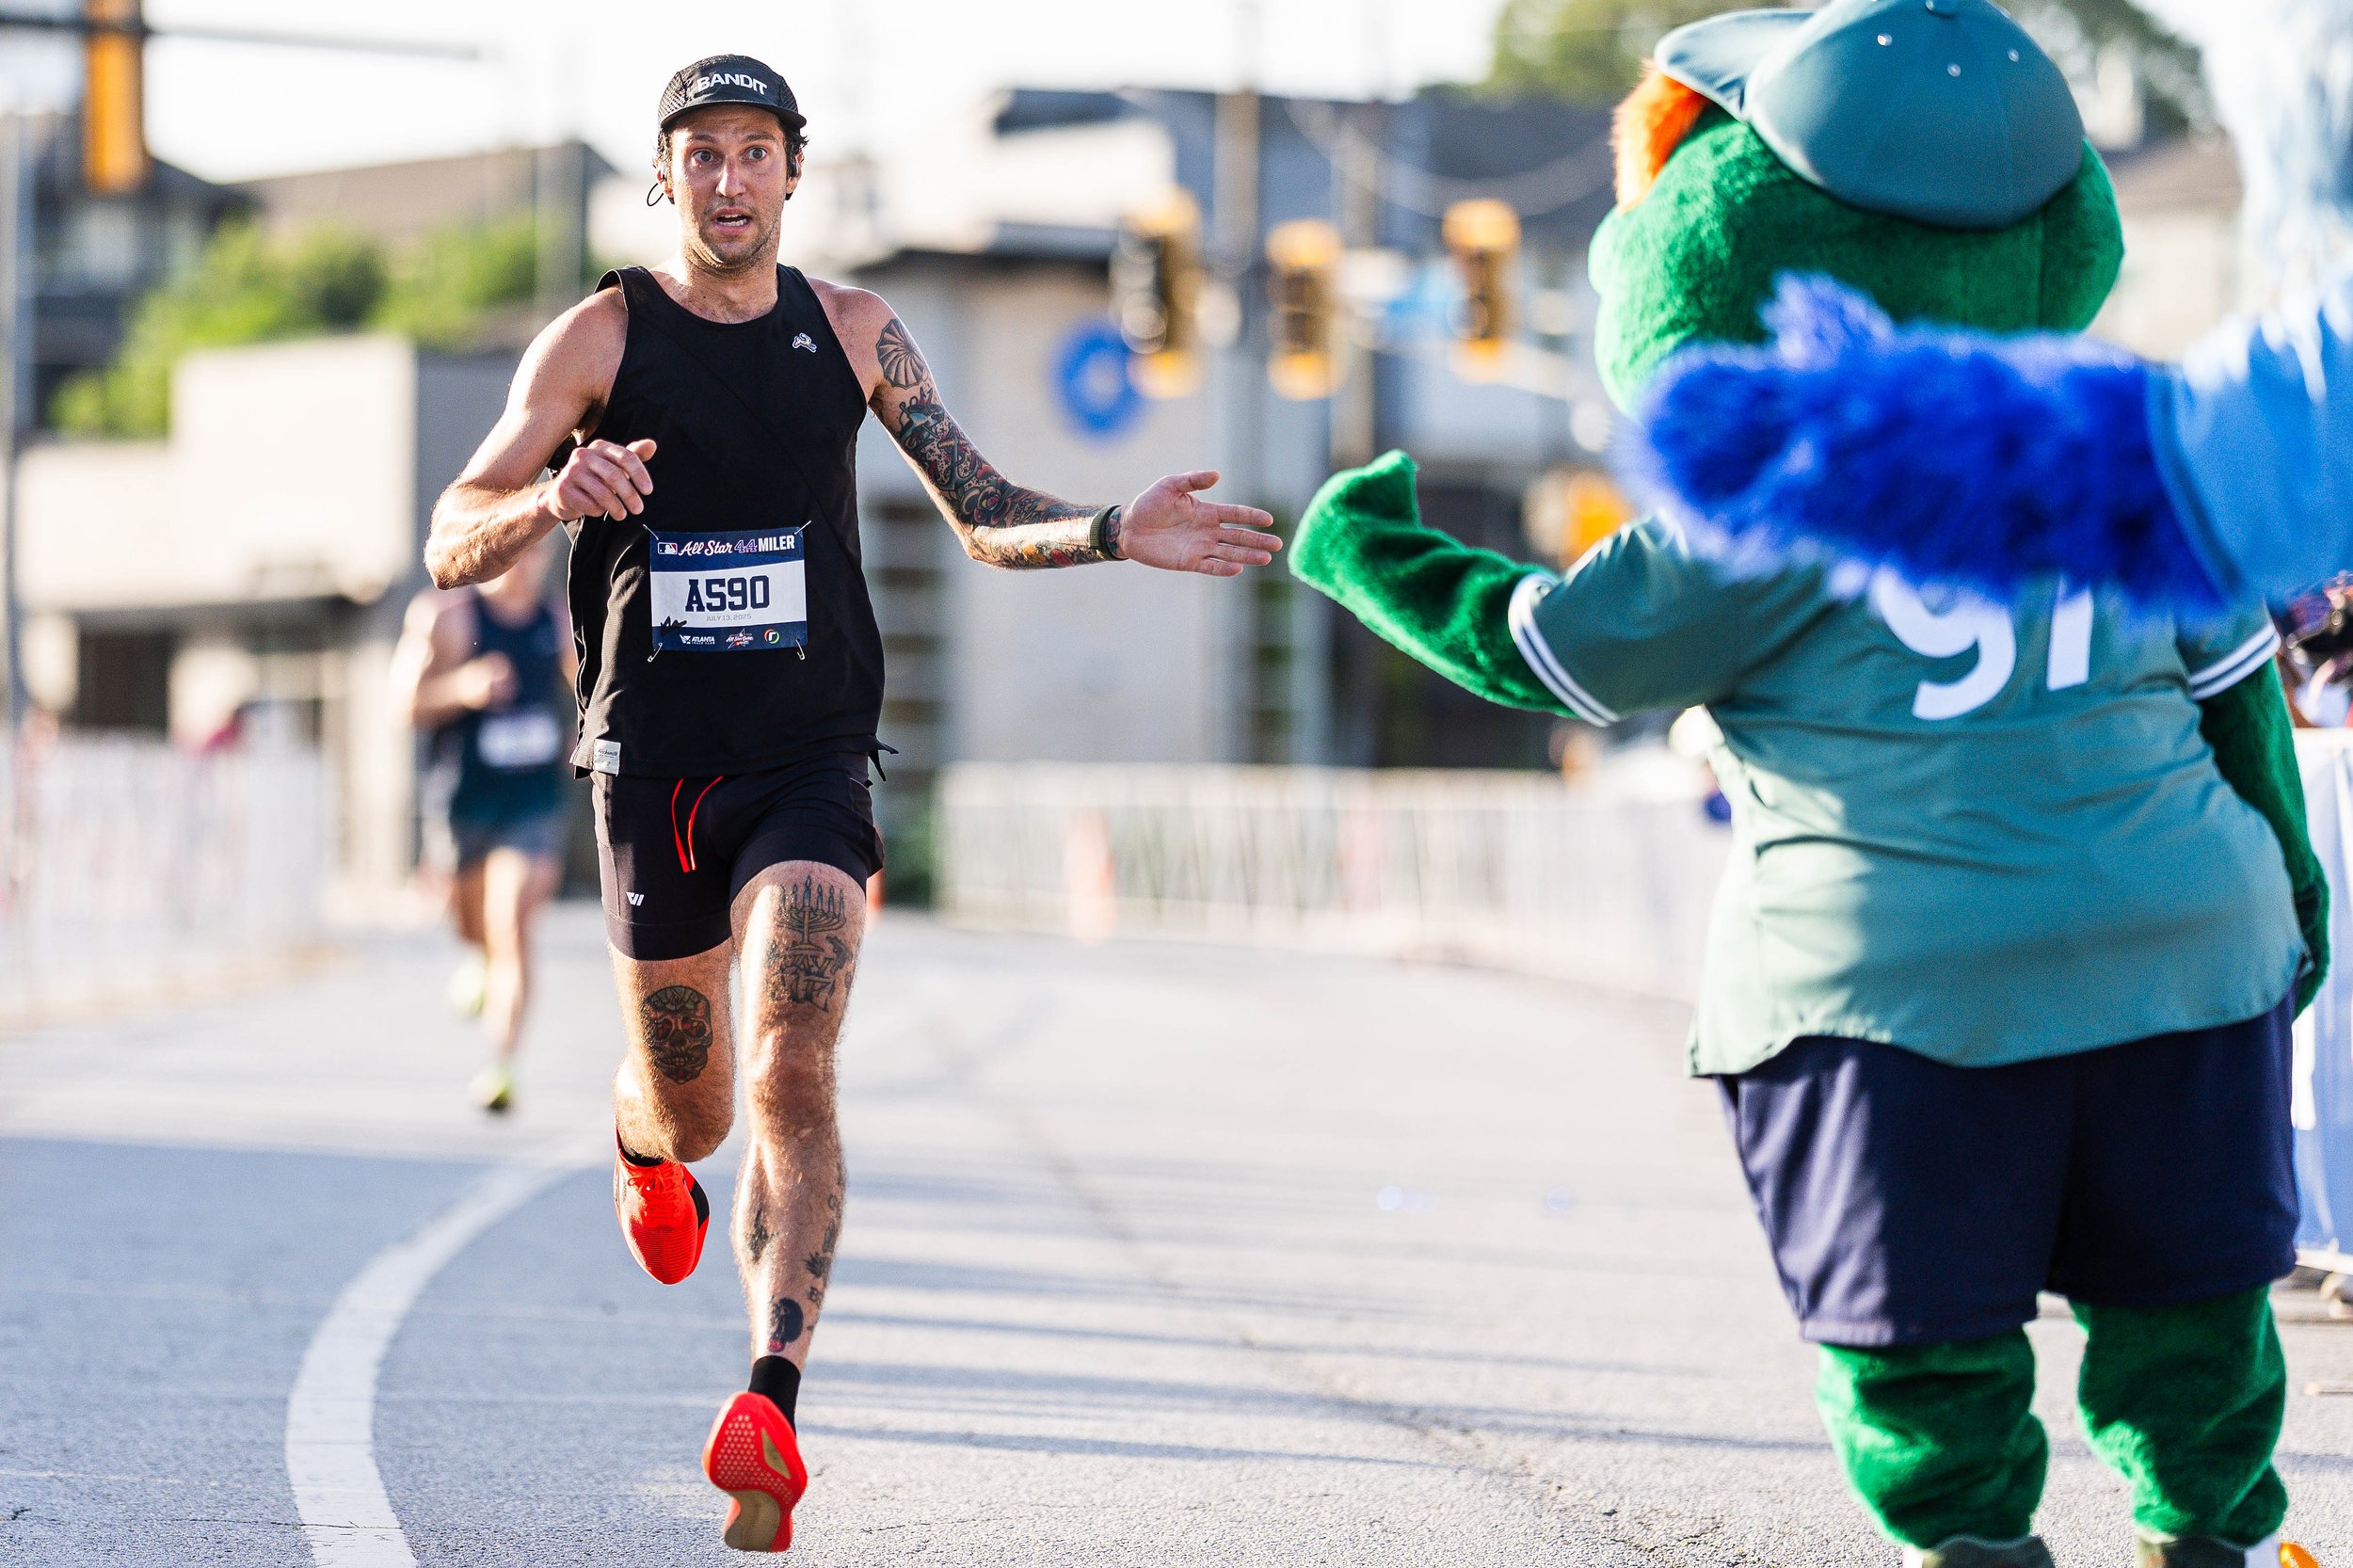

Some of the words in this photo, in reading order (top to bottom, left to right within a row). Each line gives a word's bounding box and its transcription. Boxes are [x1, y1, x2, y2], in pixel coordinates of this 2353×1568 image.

[696, 73, 768, 95] BANDIT
[678, 541, 703, 556] All
[704, 540, 732, 556] Star
[758, 535, 795, 552] MILER
[685, 575, 770, 612] A590
